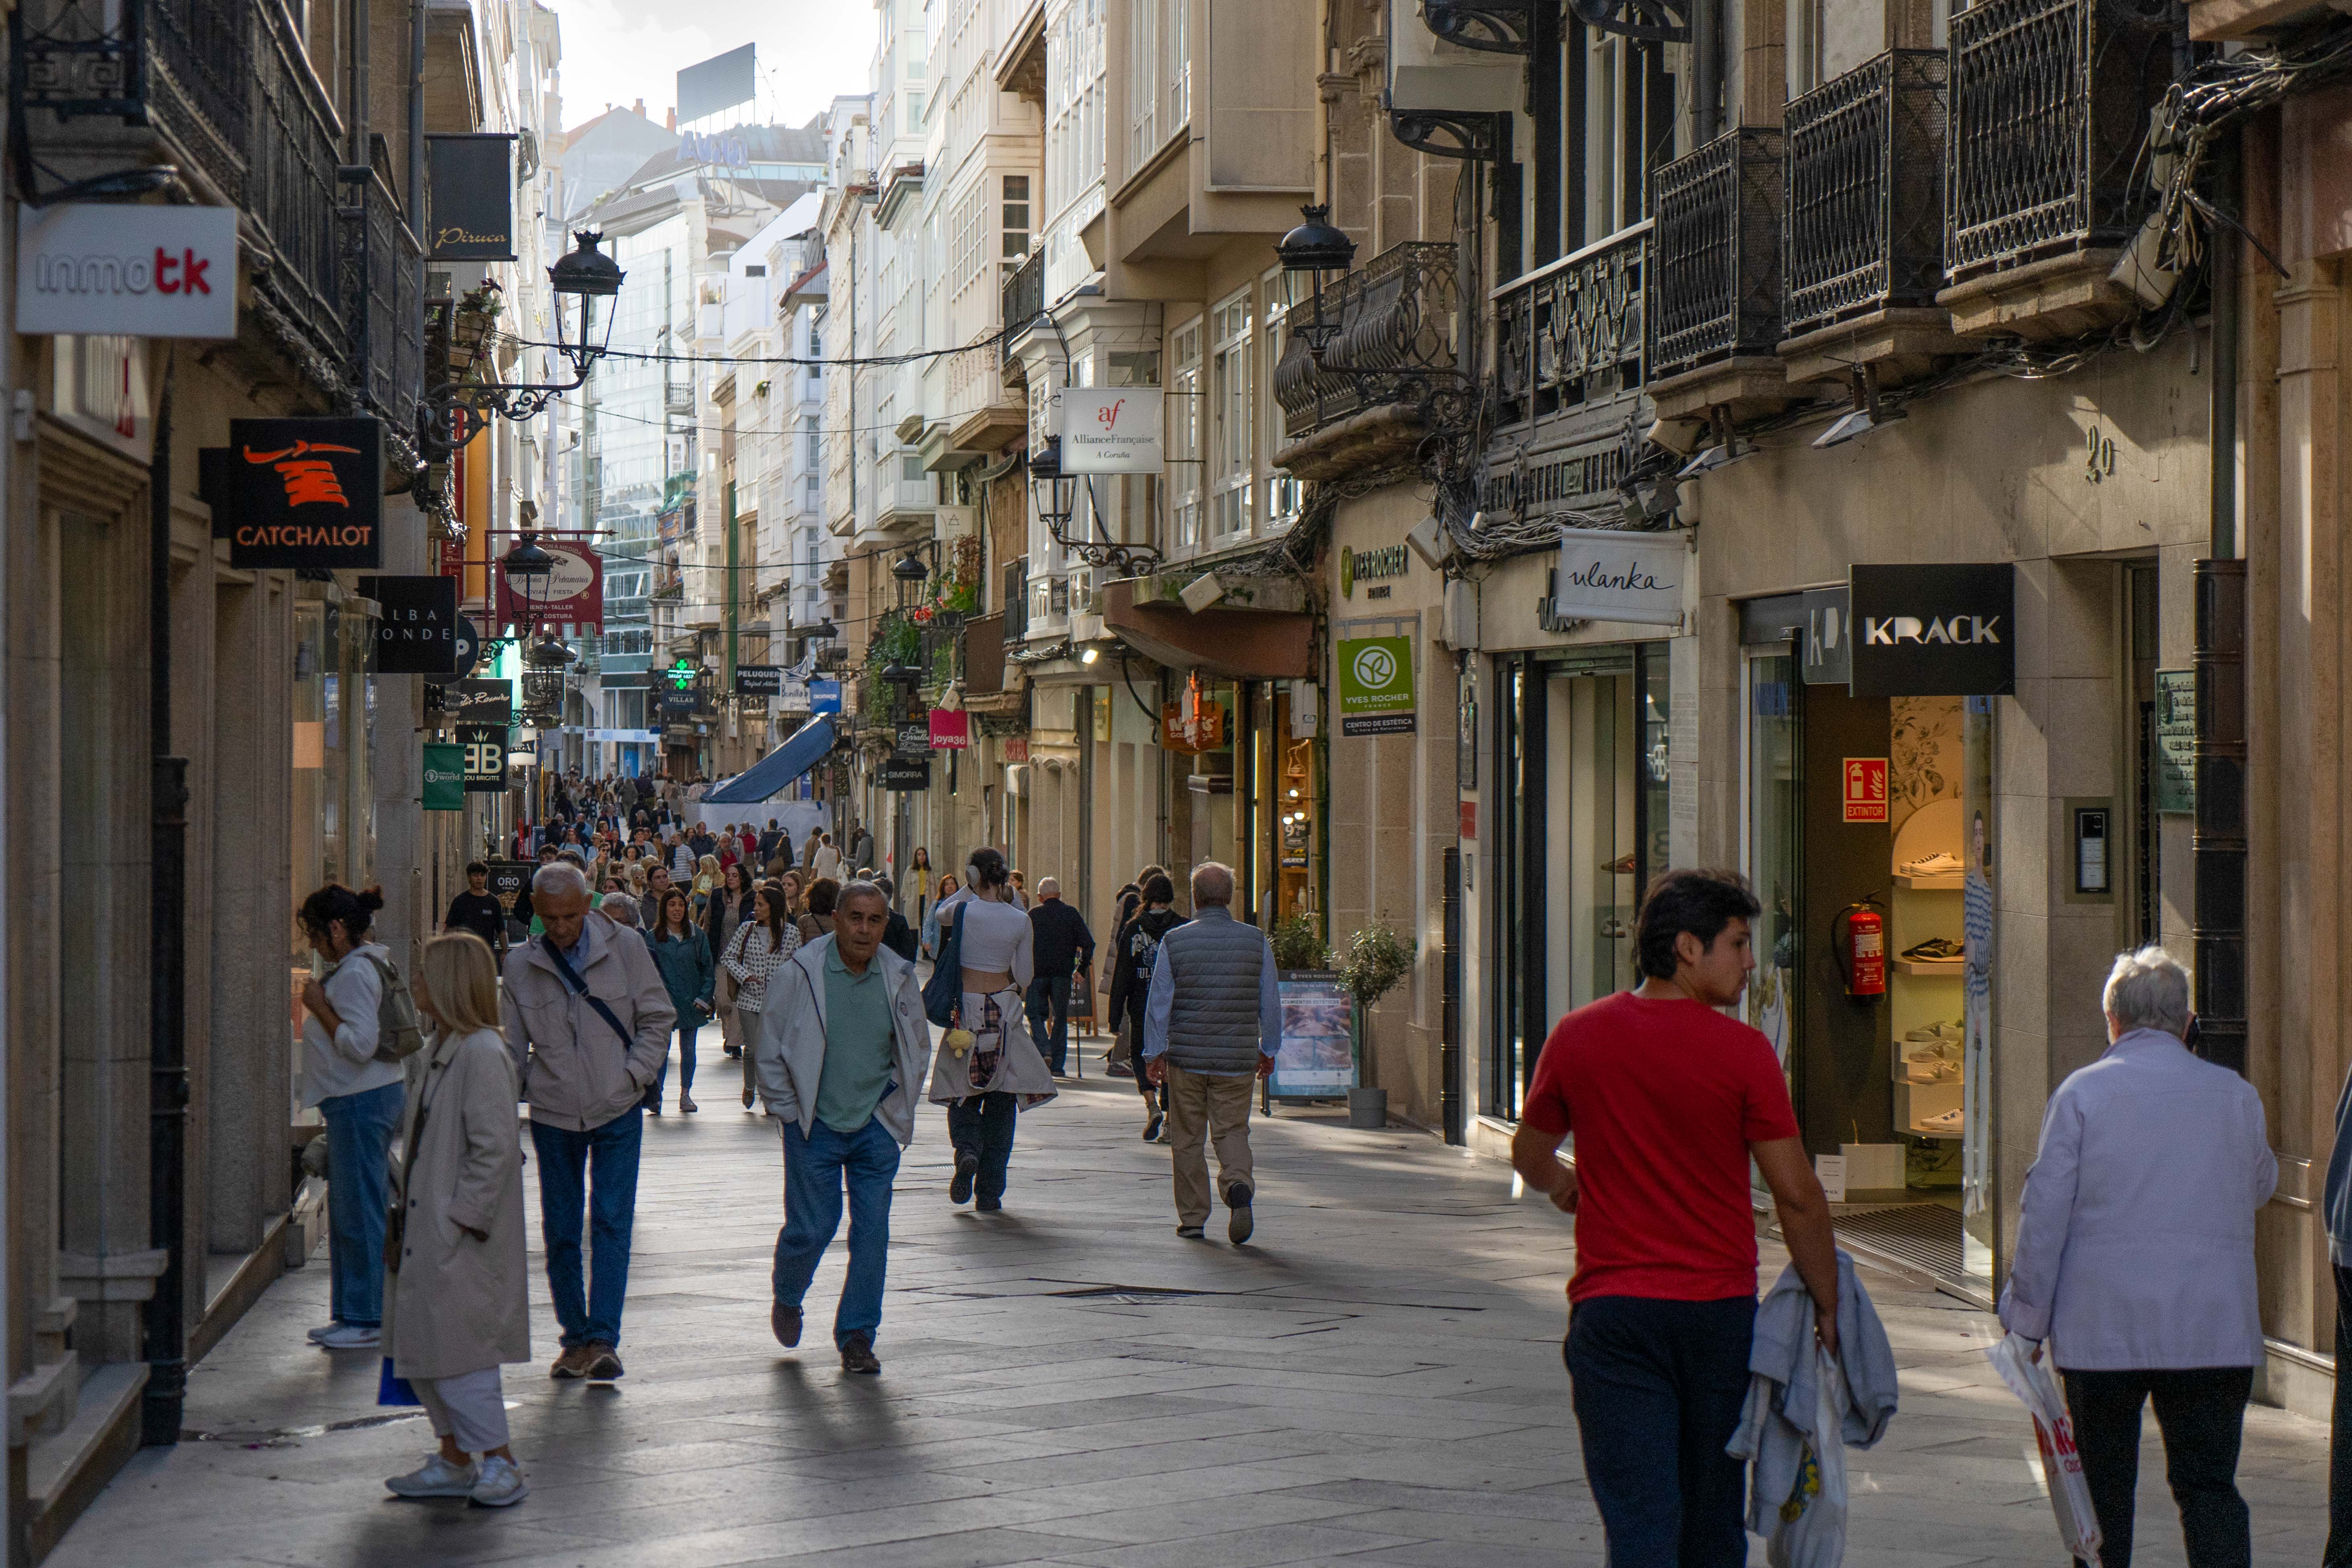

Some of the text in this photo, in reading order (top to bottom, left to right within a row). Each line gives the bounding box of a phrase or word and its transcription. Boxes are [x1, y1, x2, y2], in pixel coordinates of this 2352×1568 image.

[1104, 450, 1130, 459] Coruña
[236, 526, 372, 547] CATCHALOT
[559, 544, 582, 556] MEDIDA
[1568, 562, 1675, 590] ulanka
[379, 609, 437, 621] LBA
[1865, 615, 2001, 645] KRACK
[782, 684, 803, 697] Bonilla
[1346, 693, 1409, 704] YVES ROCHER
[932, 734, 966, 745] joya36
[1848, 806, 1884, 817] EXTINTOR
[497, 877, 520, 886] ORO
